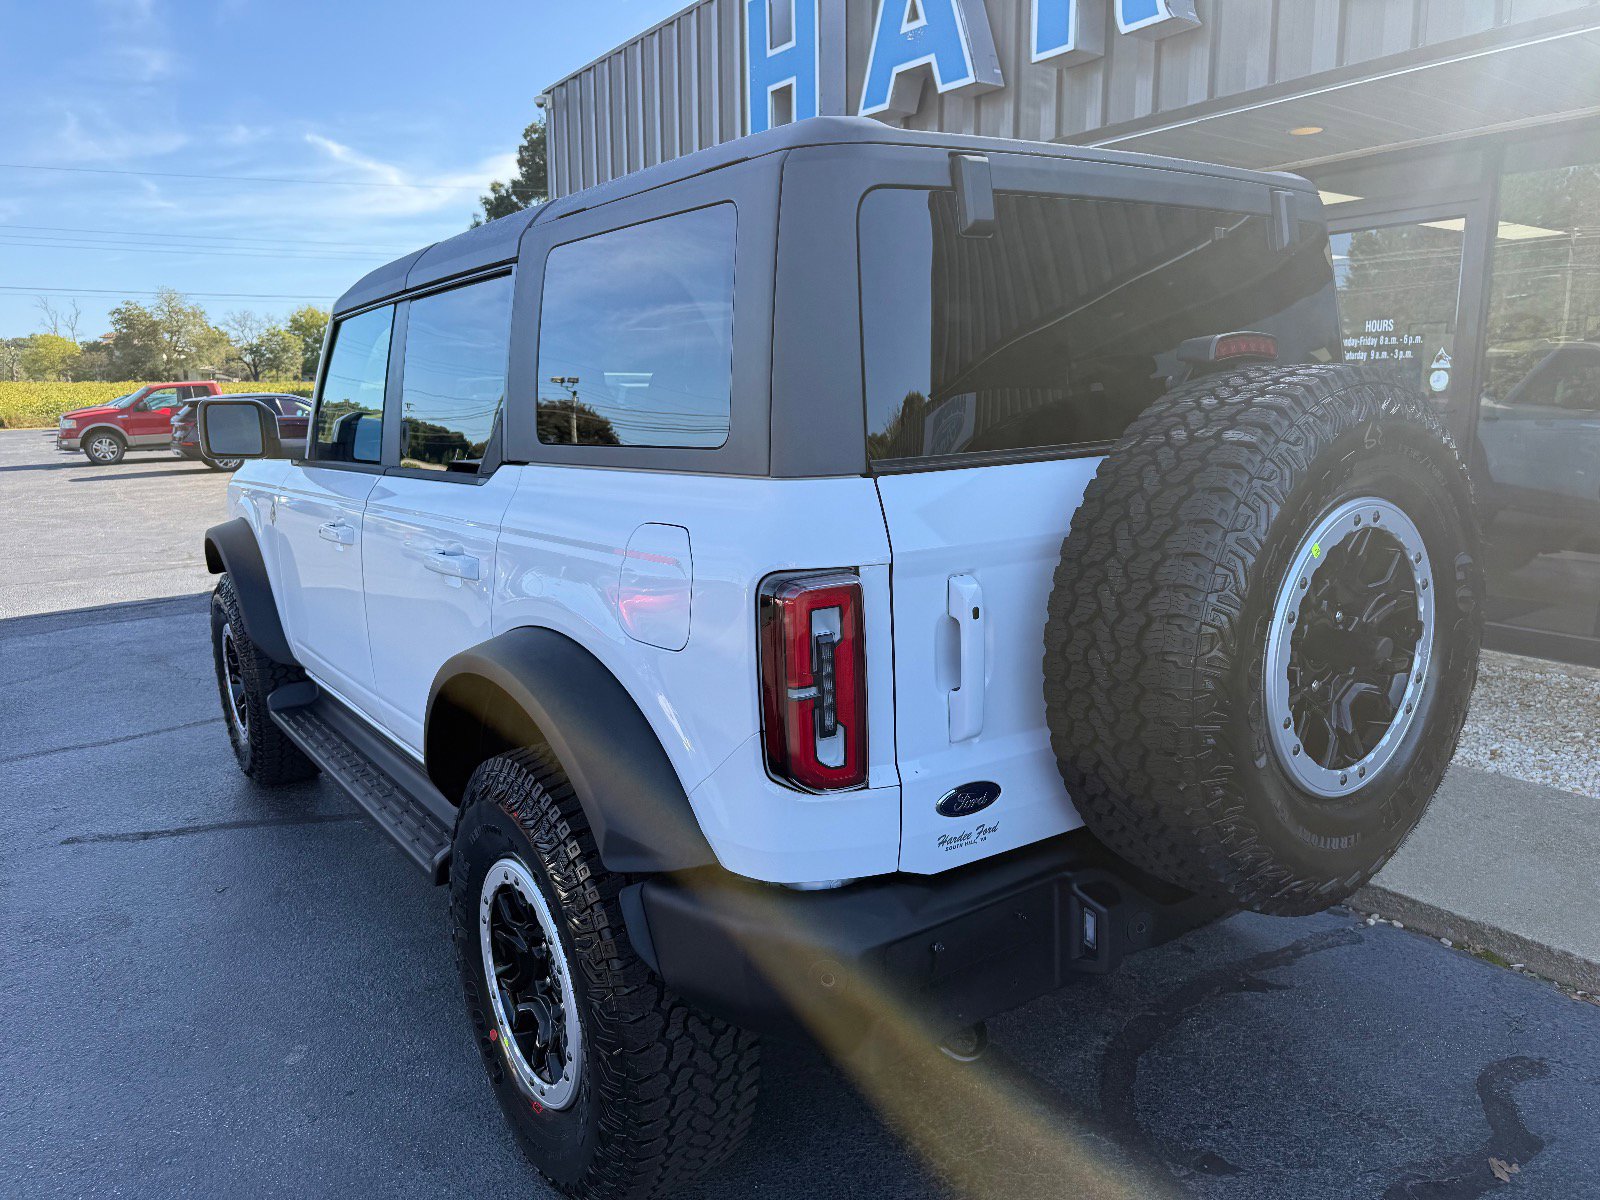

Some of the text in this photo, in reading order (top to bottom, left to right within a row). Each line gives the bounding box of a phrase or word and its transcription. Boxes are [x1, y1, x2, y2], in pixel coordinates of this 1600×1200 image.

[1365, 319, 1394, 332] HOURS
[1343, 335, 1378, 347] nday-Friday
[1379, 335, 1384, 345] 8
[1385, 336, 1399, 345] a.m.
[1403, 334, 1408, 344] 6
[1408, 335, 1423, 346] p.m.
[1344, 350, 1367, 361] aturday
[1370, 350, 1375, 360] 9
[1394, 349, 1399, 359] 3
[1399, 350, 1413, 361] p.m.
[954, 791, 988, 811] Ford
[937, 820, 1000, 848] Hardee Ford
[945, 843, 964, 852] SOUTH
